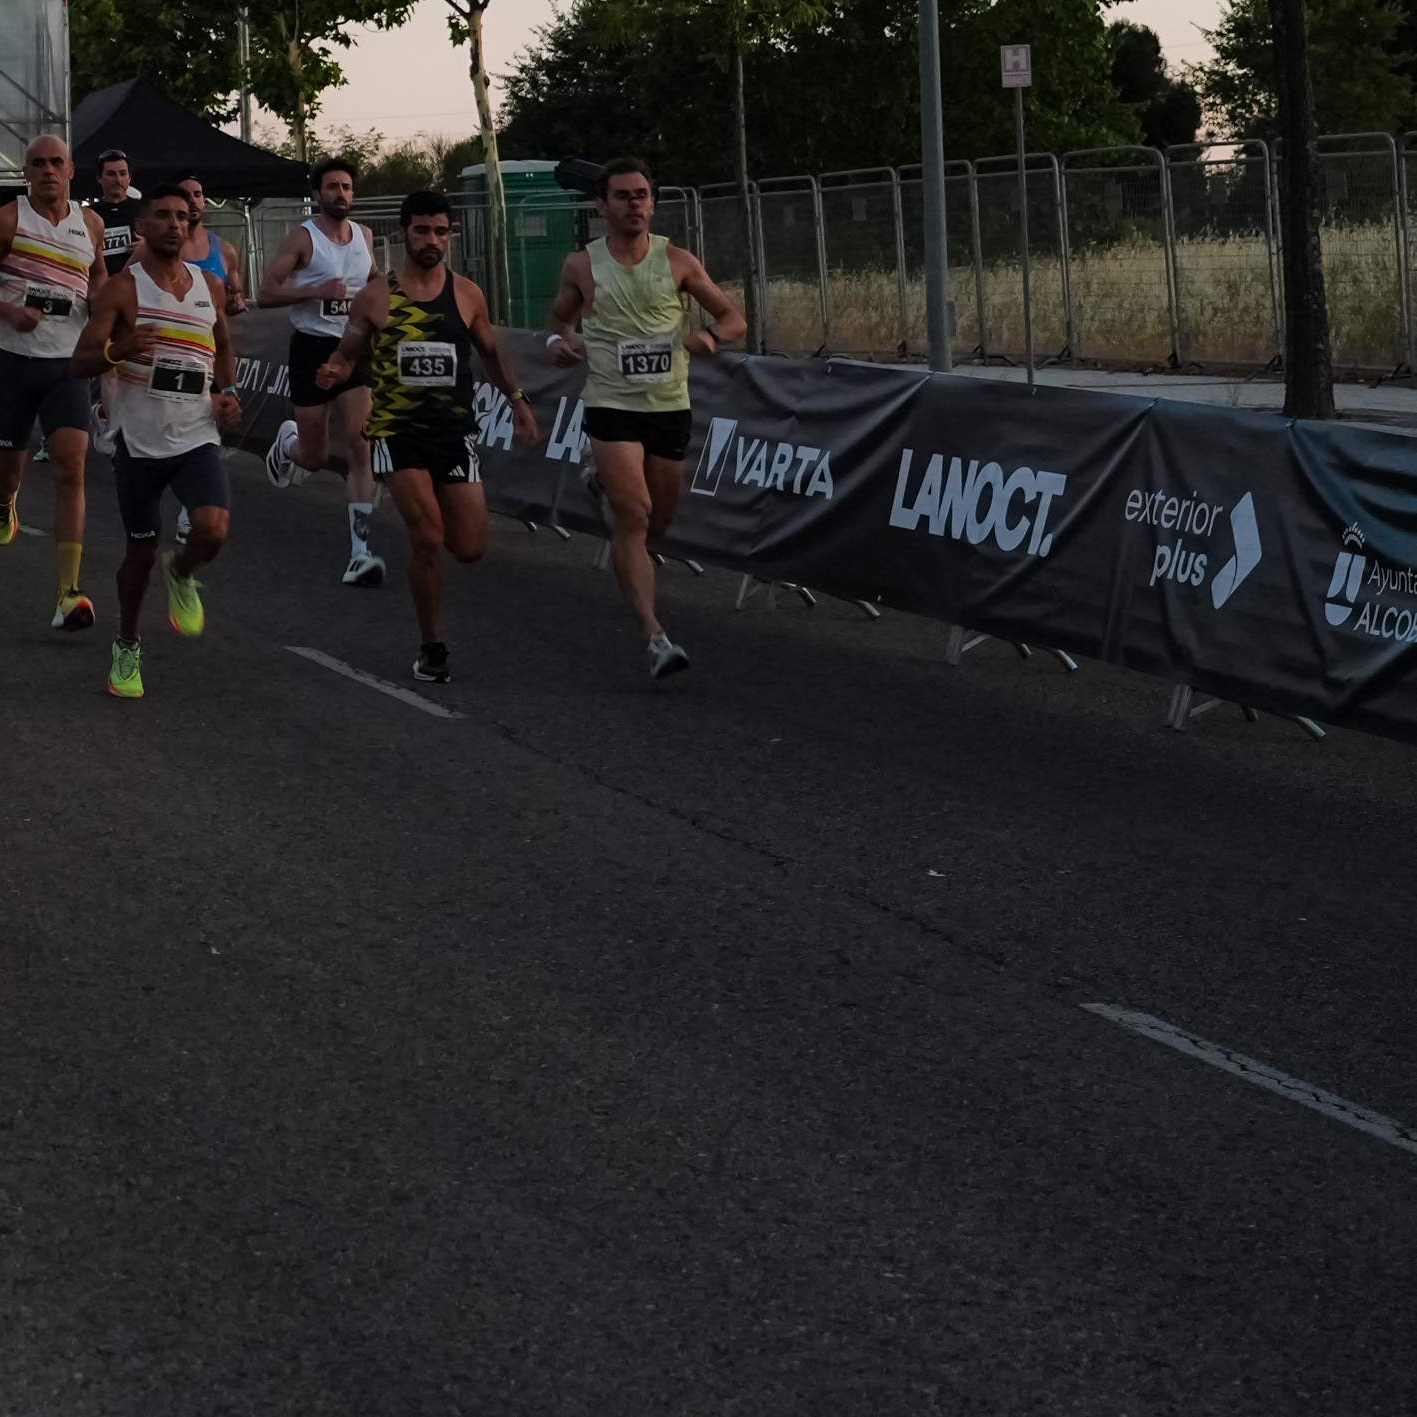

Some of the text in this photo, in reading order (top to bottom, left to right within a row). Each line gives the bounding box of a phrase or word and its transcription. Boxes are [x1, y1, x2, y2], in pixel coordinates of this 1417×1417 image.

[42, 299, 54, 314] 3
[330, 299, 352, 315] 54
[409, 357, 446, 376] 435
[625, 353, 670, 373] 1370
[174, 372, 185, 390] 1
[472, 381, 515, 452] OKA
[733, 434, 834, 499] VARTA
[888, 448, 1067, 560] LANOCT.
[1125, 486, 1224, 538] exterior
[1149, 540, 1208, 587] plus
